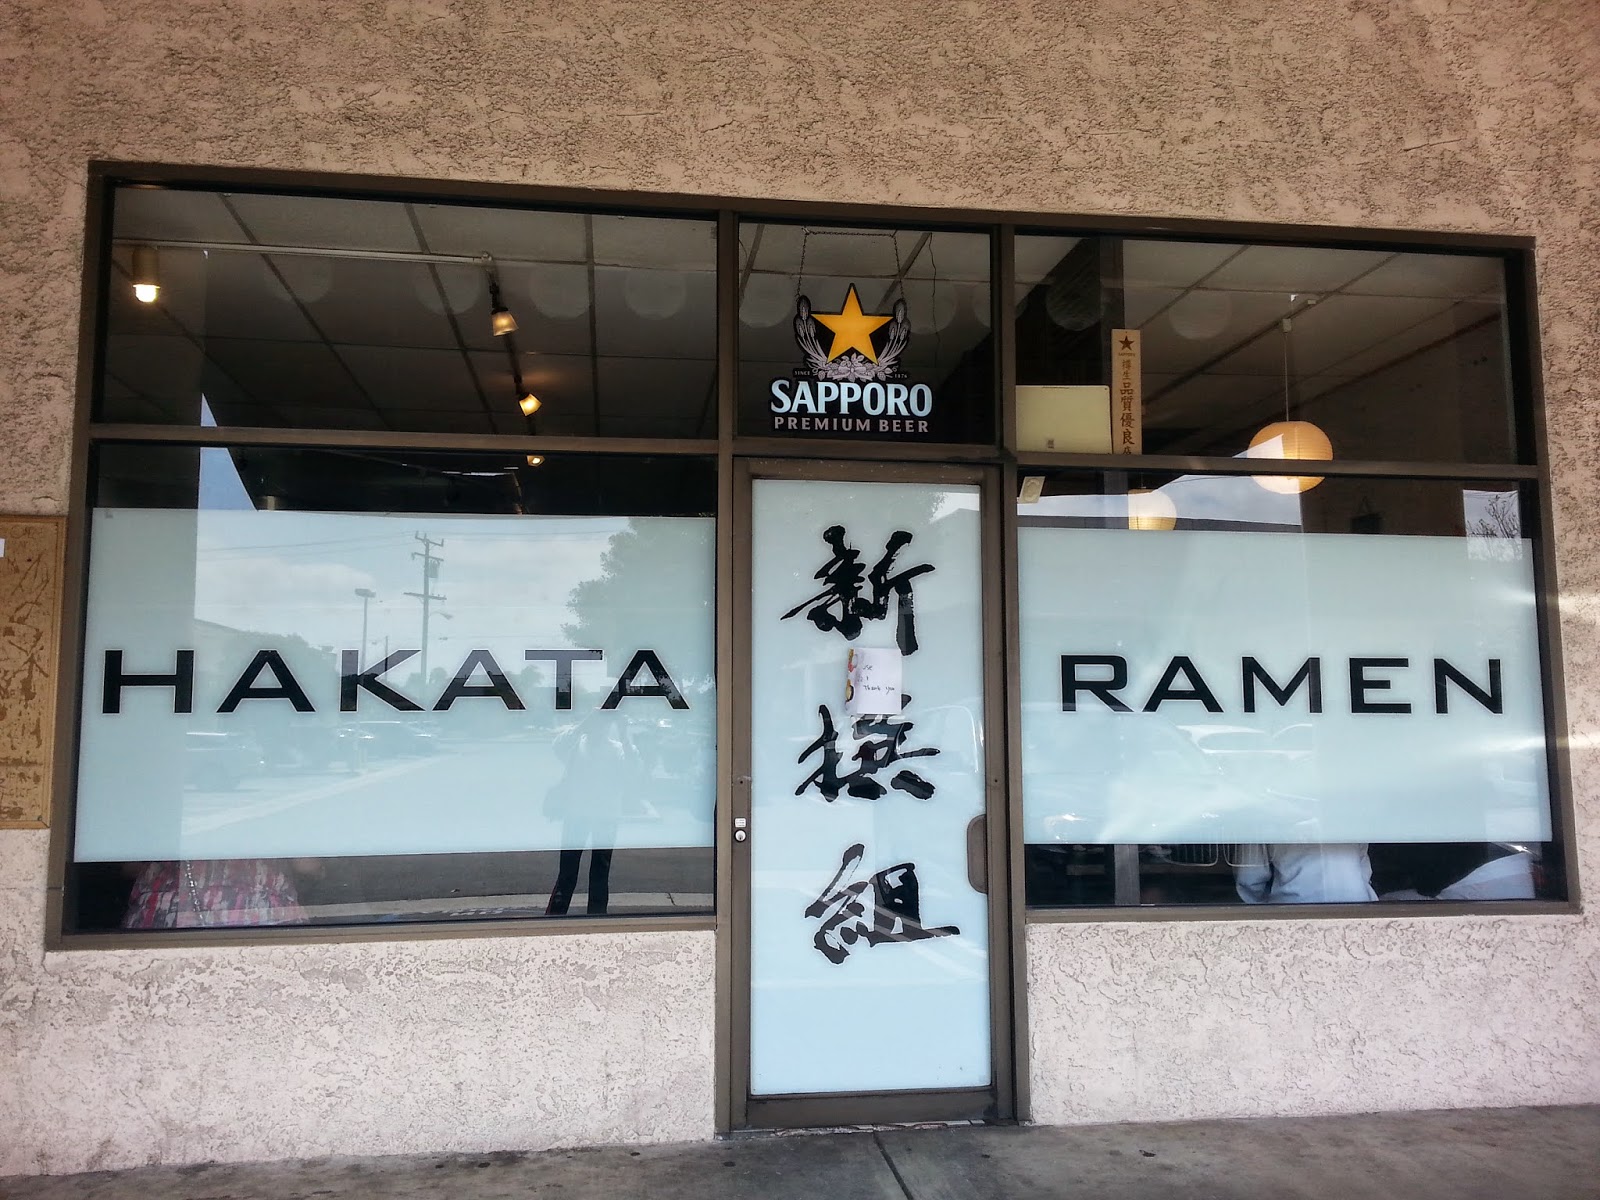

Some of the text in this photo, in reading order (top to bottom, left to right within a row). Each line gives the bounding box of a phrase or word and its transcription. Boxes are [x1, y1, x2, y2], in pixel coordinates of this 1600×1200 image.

[770, 379, 933, 417] SAPPORO
[774, 416, 929, 433] PREMIUM BEER
[102, 648, 691, 714] HAKATA
[885, 685, 895, 695] you
[1061, 653, 1504, 714] RAMEN
